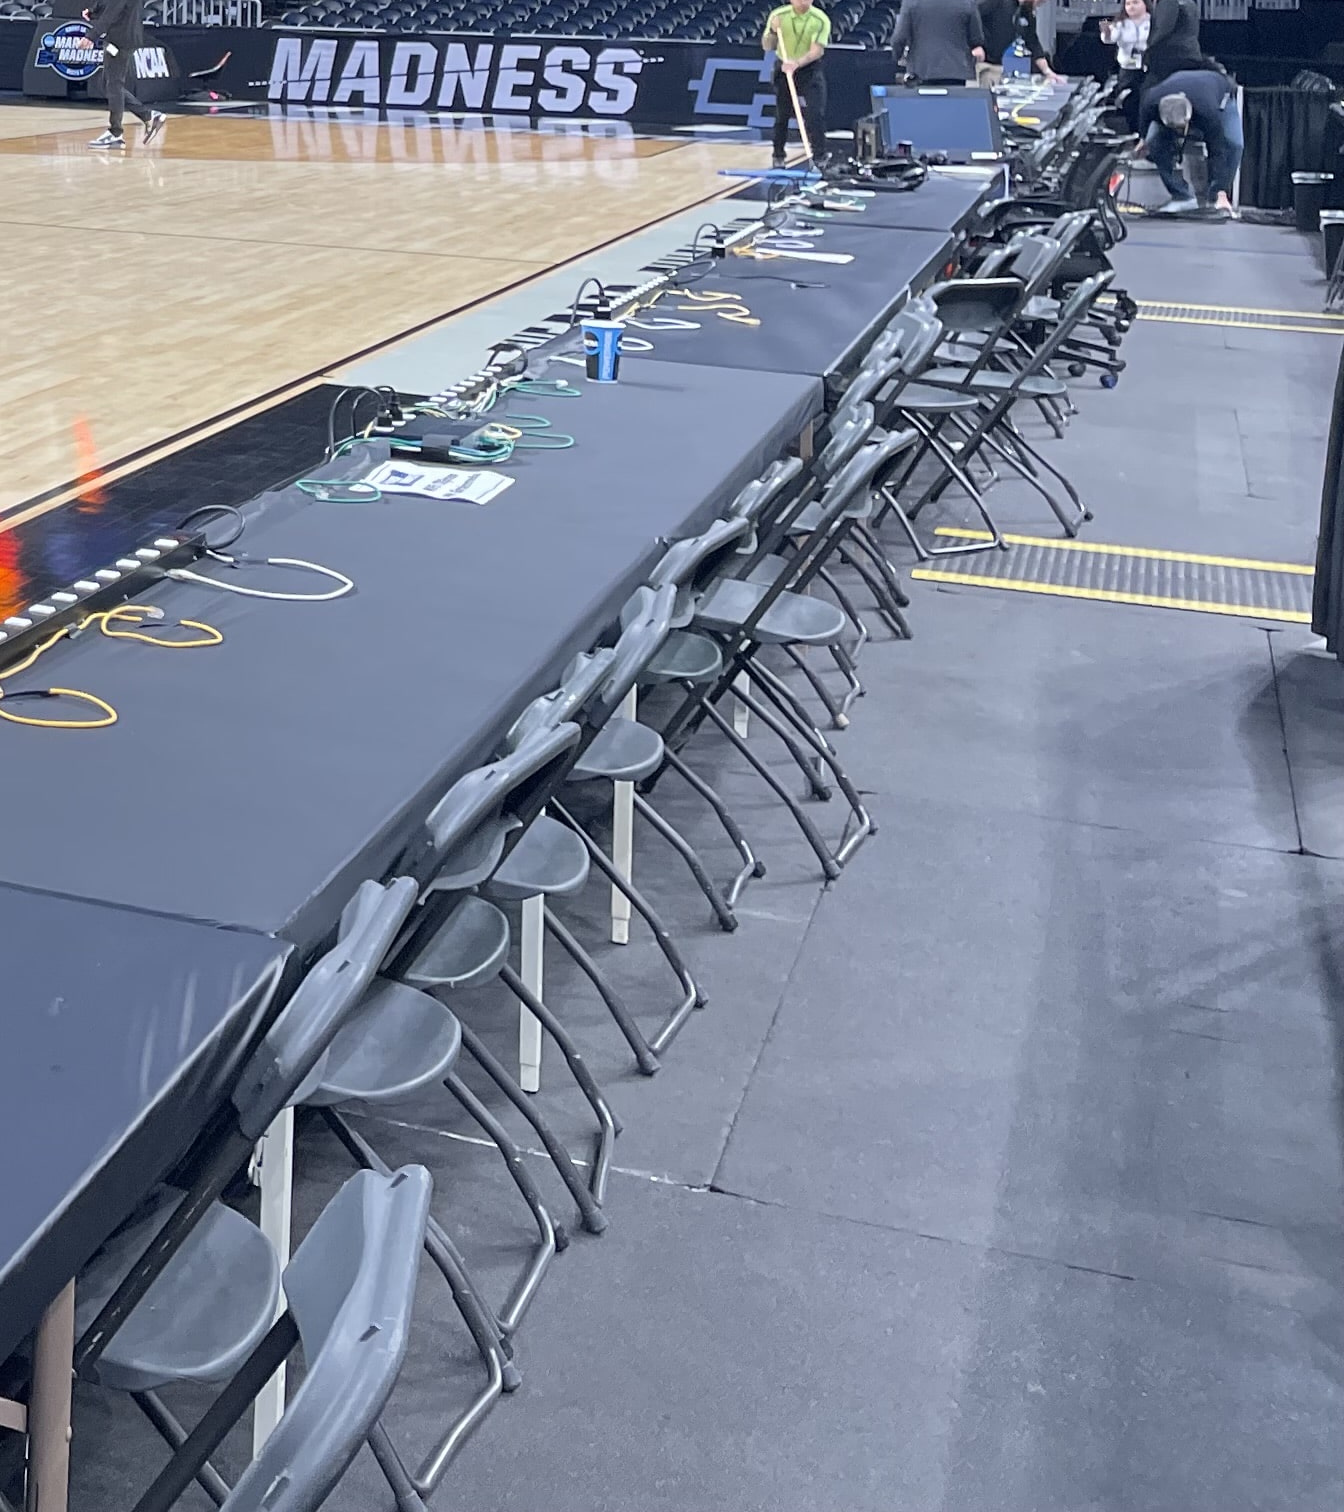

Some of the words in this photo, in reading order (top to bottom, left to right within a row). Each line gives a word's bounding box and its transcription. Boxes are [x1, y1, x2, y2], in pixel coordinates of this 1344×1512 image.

[55, 36, 94, 49] MAR
[58, 48, 104, 62] MADNES
[134, 47, 170, 78] NCAA
[267, 37, 644, 115] MADNESS
